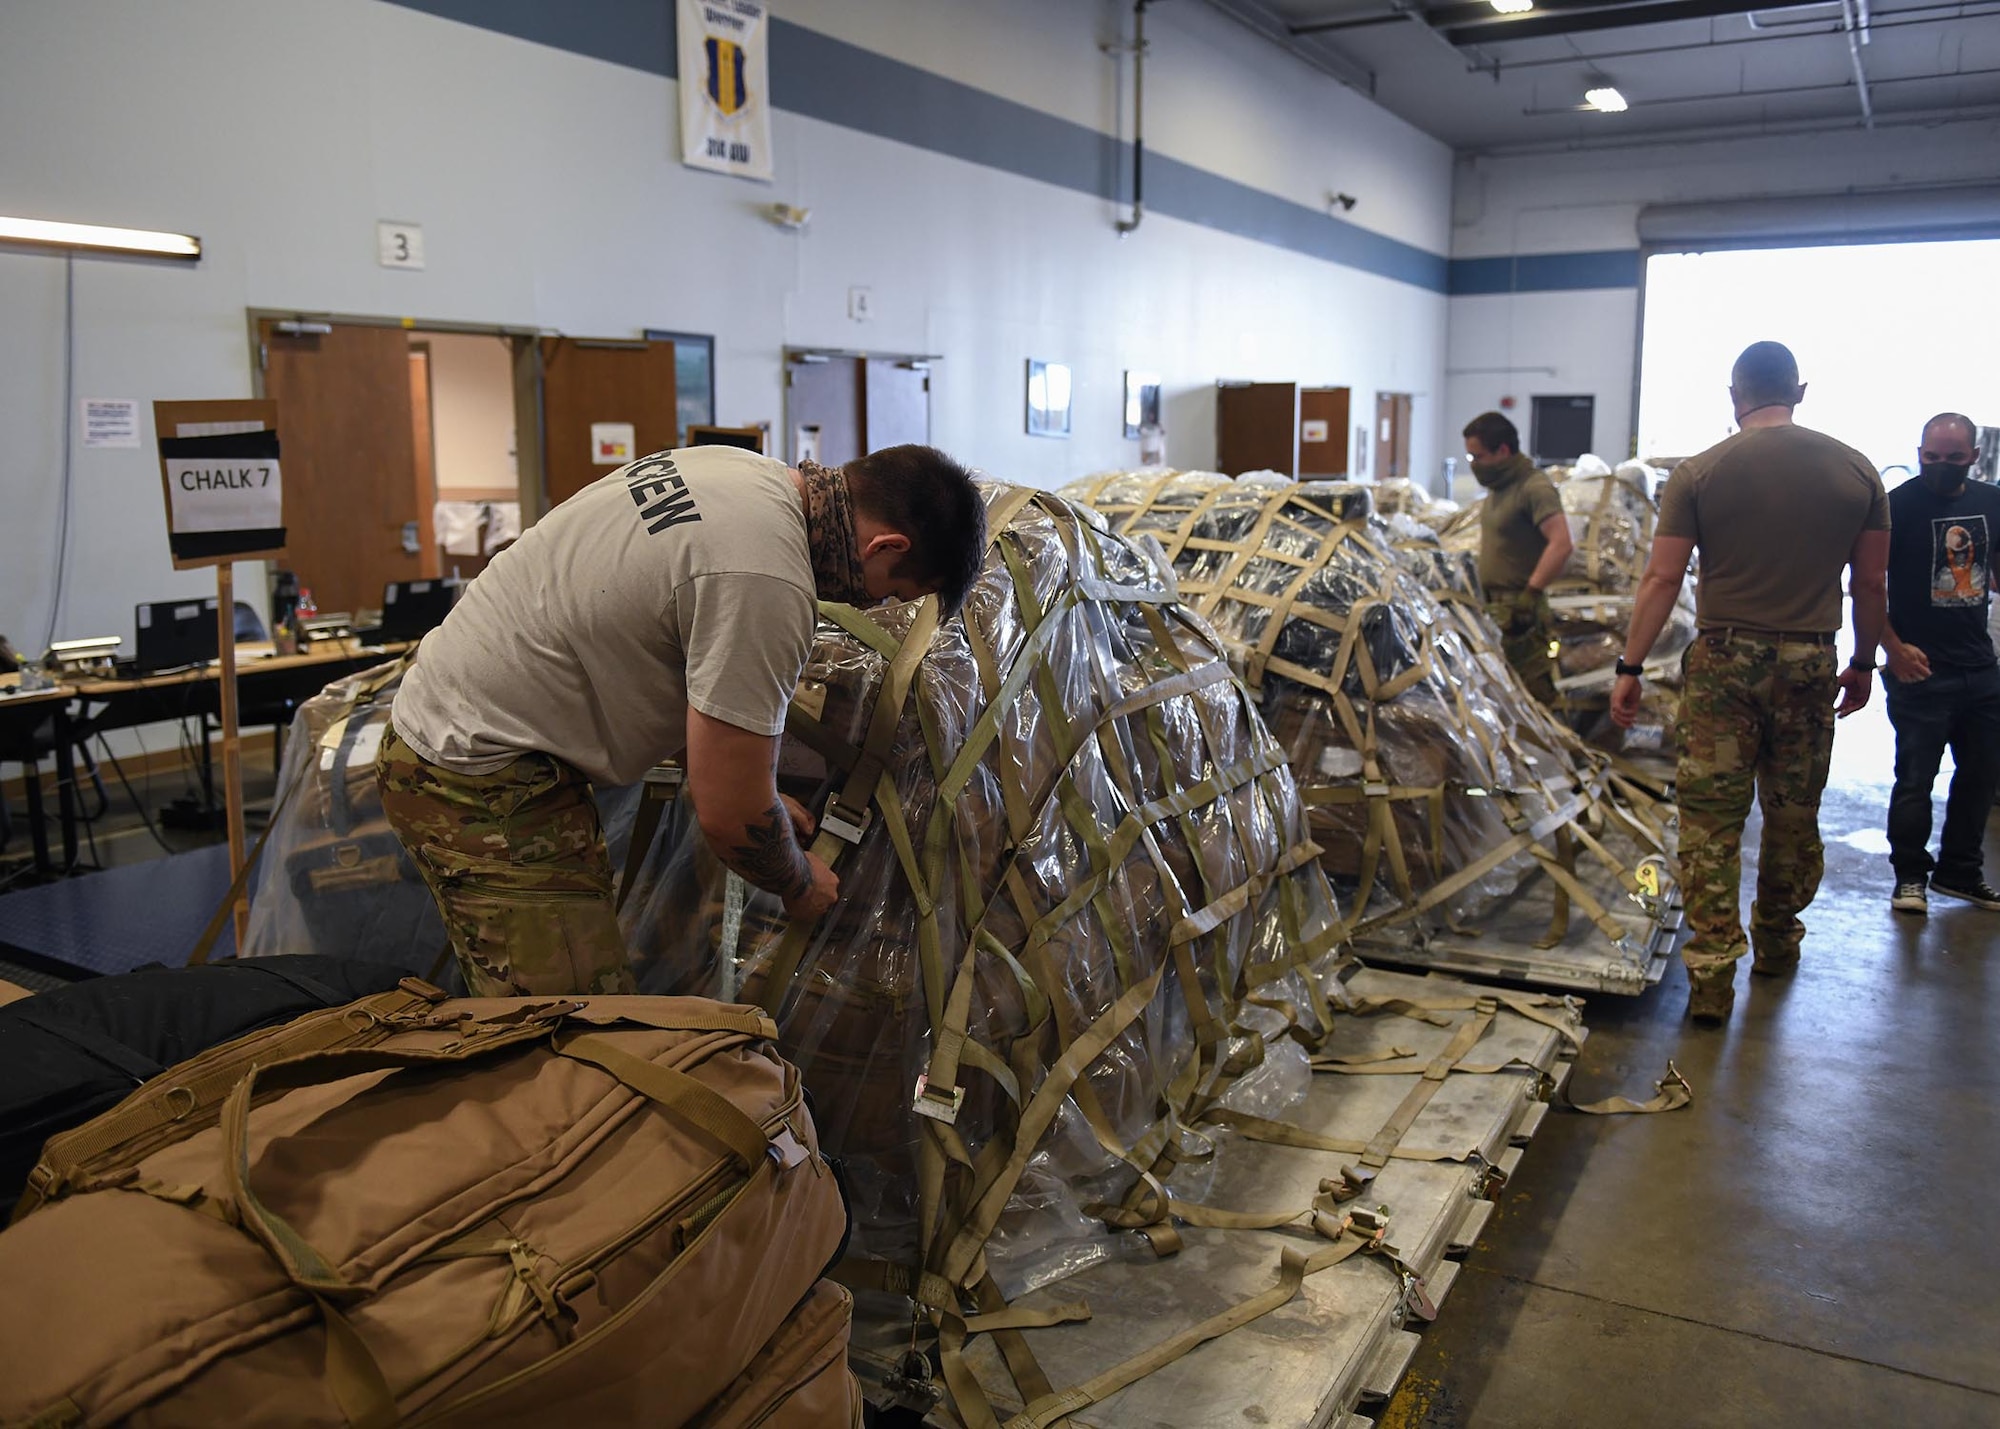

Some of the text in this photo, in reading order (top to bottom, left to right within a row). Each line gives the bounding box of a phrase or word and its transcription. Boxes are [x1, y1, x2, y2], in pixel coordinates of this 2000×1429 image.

[394, 233, 409, 261] 3
[180, 468, 270, 491] CHALK 7
